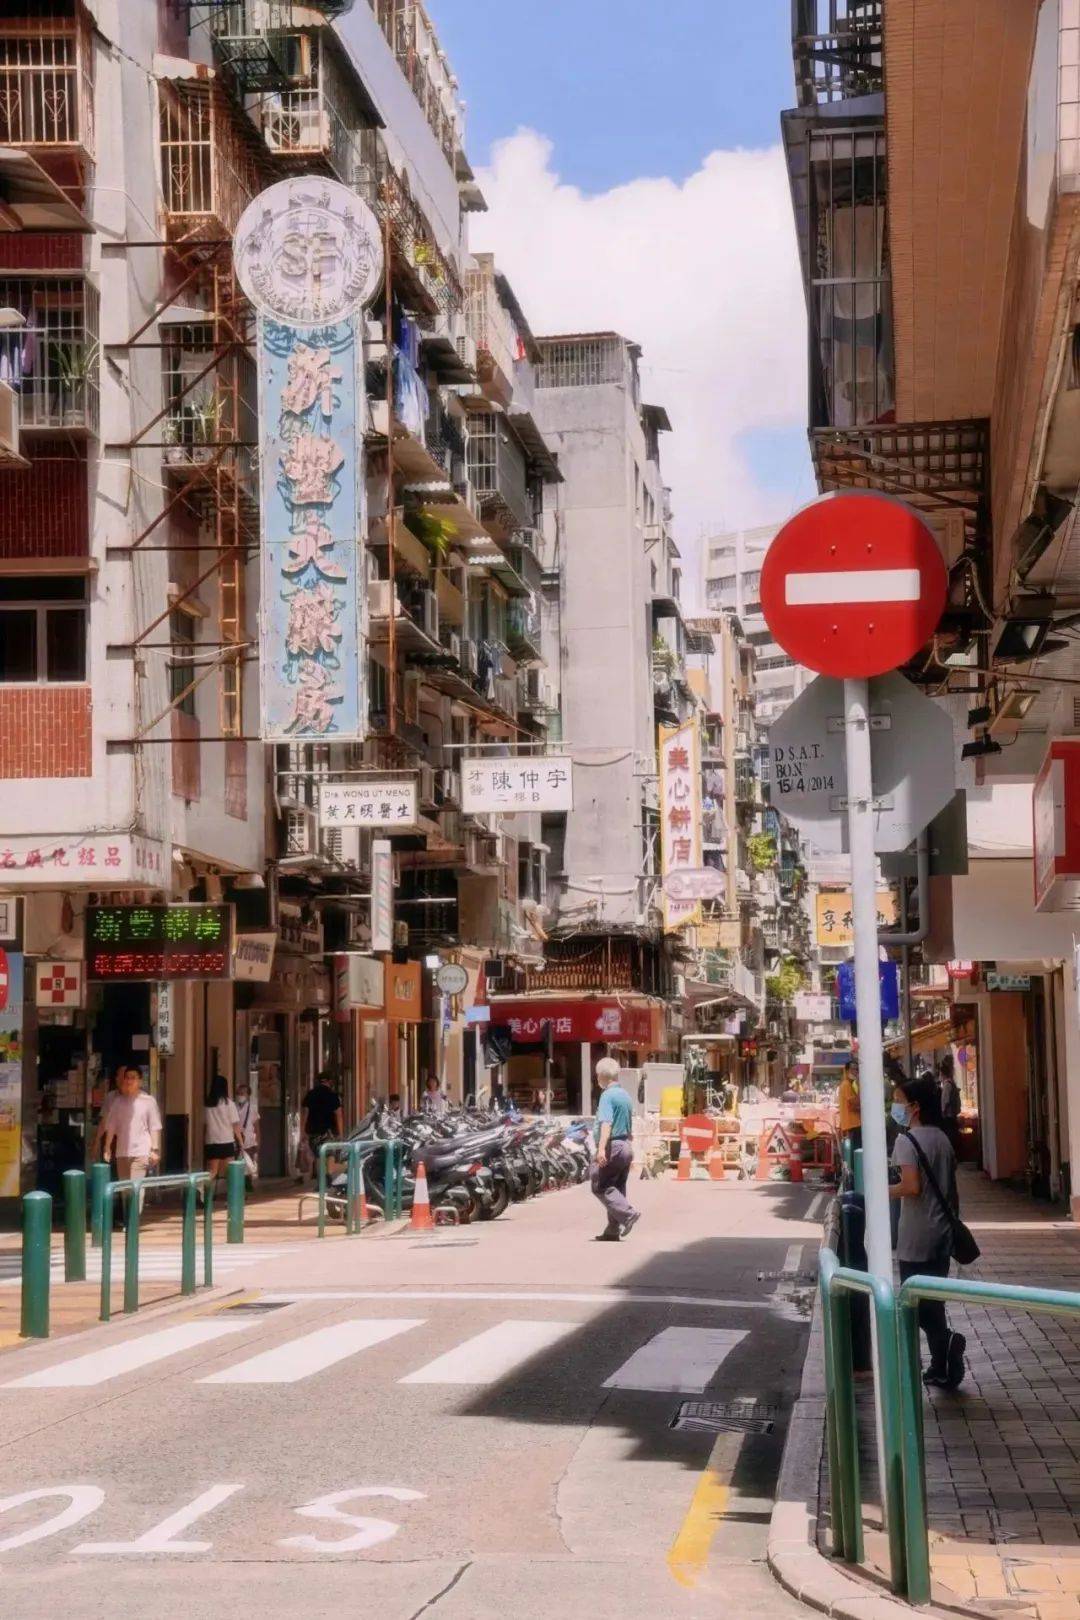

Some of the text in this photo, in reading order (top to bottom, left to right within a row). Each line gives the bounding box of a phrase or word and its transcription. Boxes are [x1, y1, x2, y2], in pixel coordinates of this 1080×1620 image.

[492, 769, 567, 790] 陳仲宇
[343, 790, 370, 798] WONG
[372, 790, 384, 798] UT
[385, 789, 411, 797] MENG
[668, 746, 692, 866] 美心餅店
